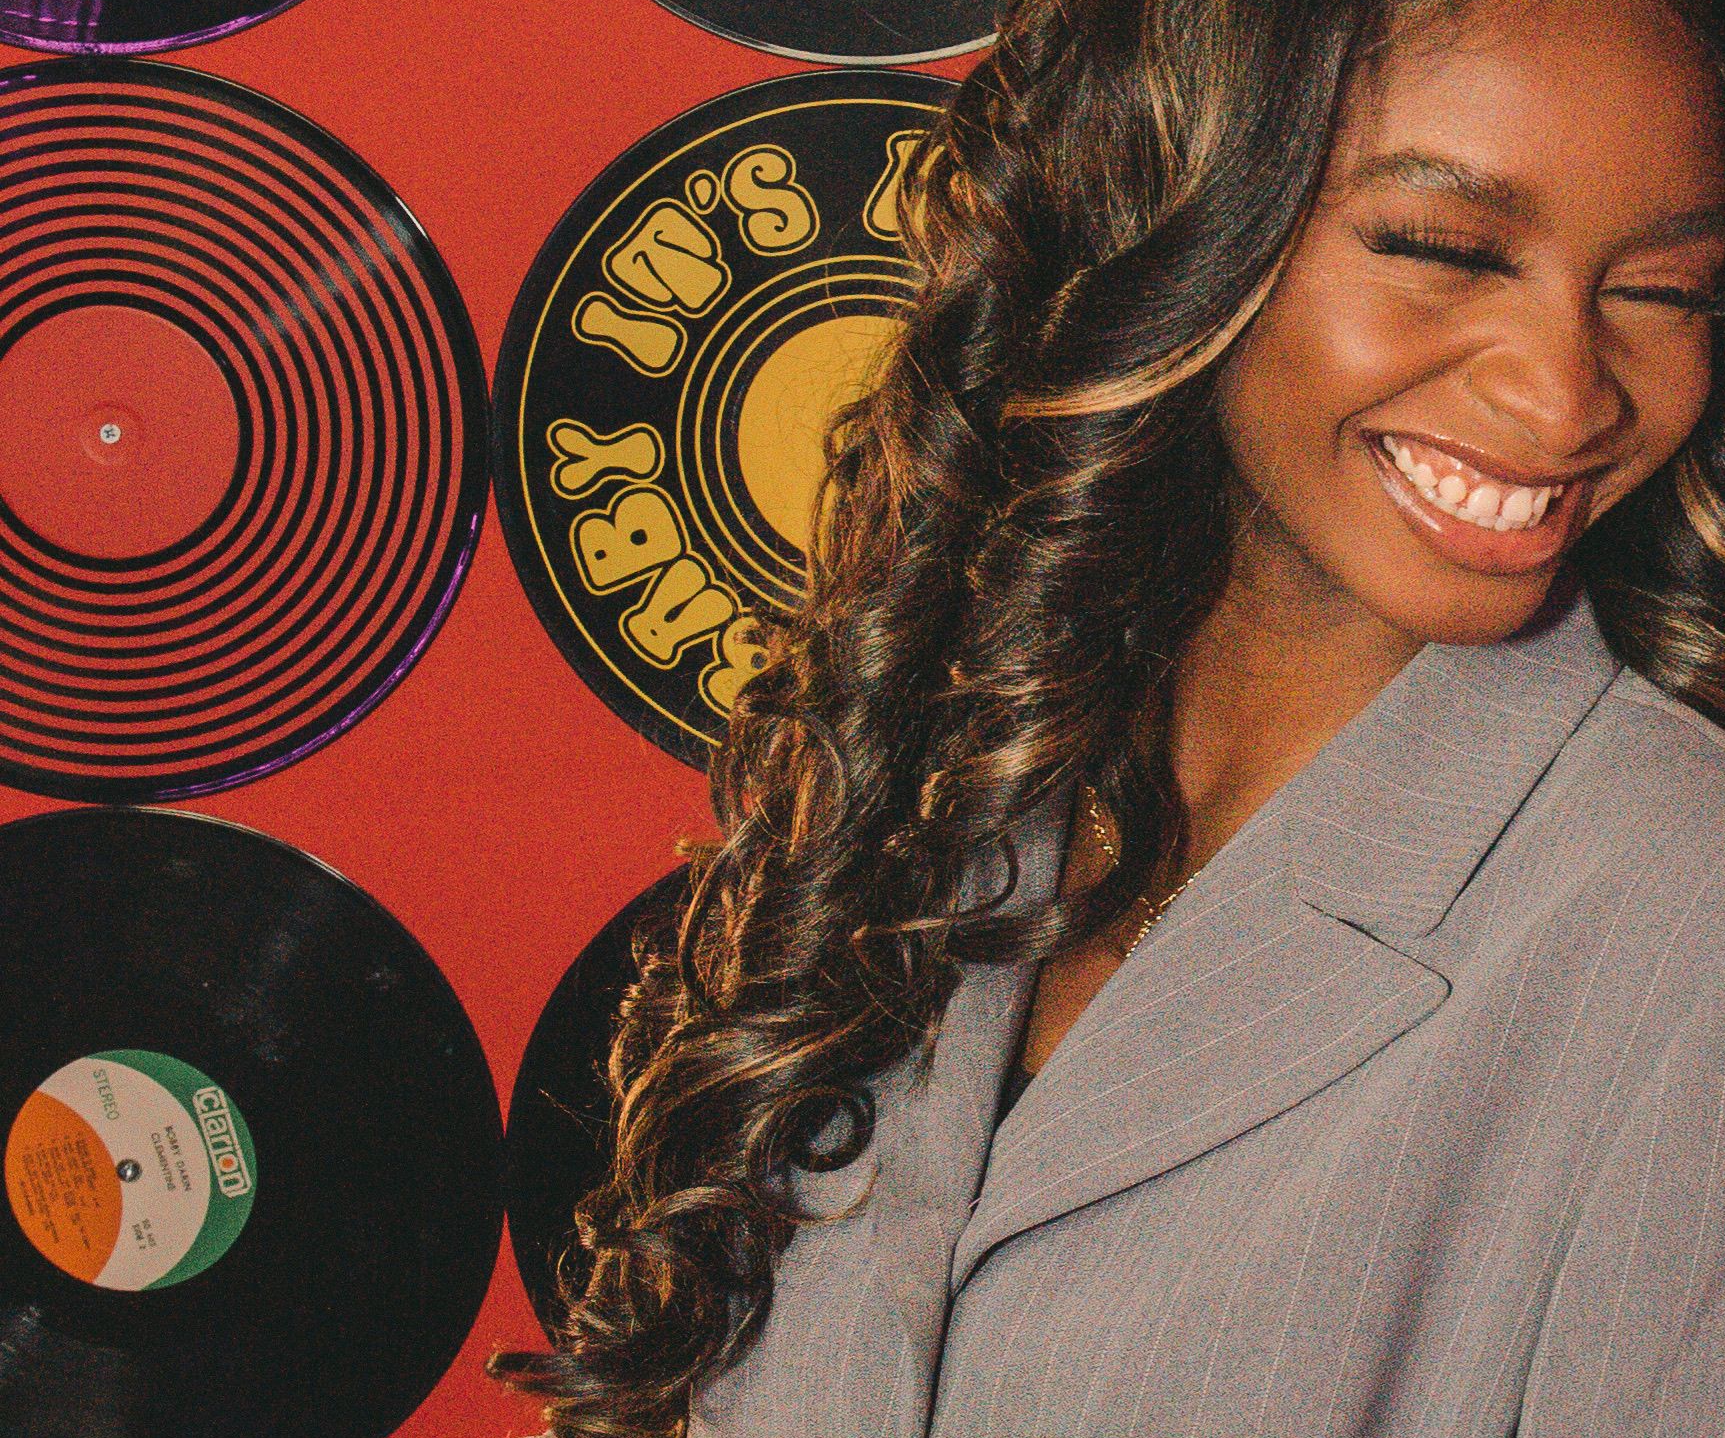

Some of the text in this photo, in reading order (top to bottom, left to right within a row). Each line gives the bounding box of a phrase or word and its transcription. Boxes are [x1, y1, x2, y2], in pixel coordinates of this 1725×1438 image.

[572, 143, 821, 378] IT'S
[92, 1068, 121, 1122] STEREO
[150, 1131, 177, 1192] CLEMENTINE
